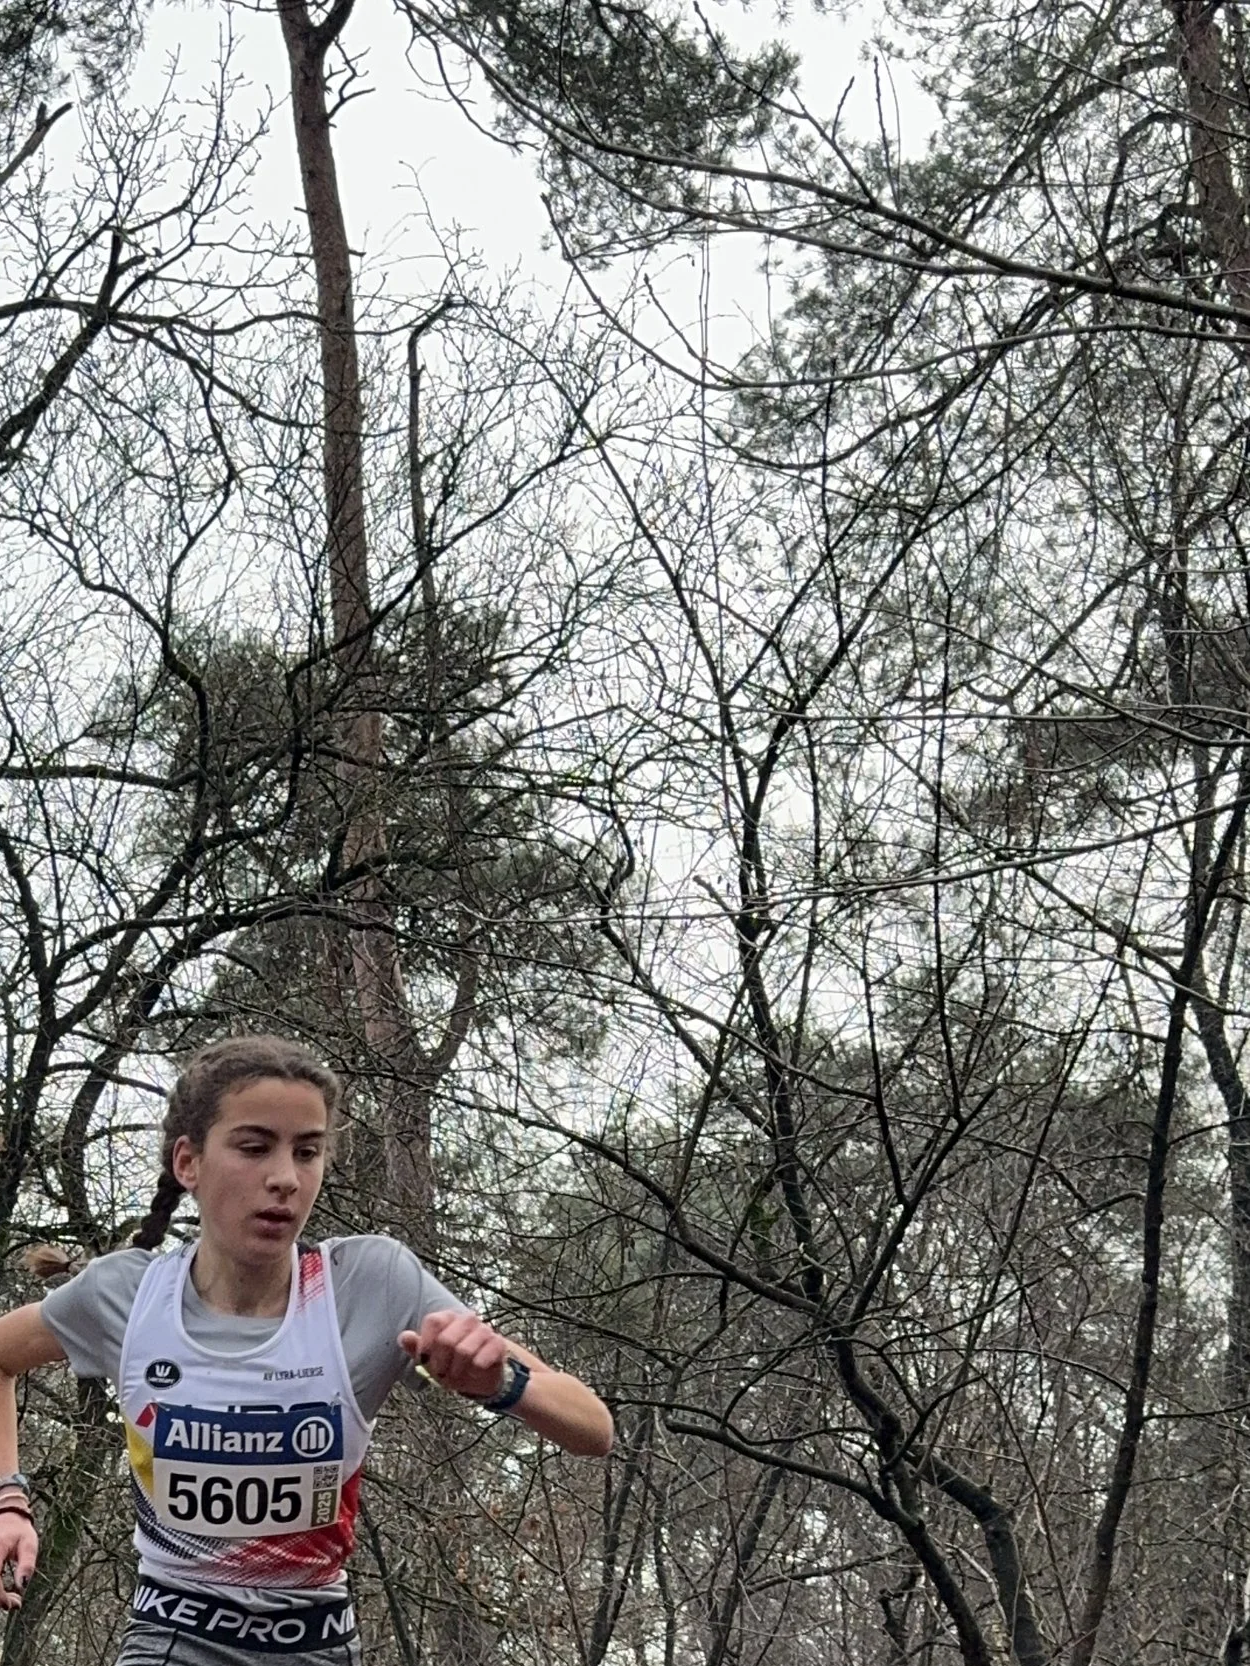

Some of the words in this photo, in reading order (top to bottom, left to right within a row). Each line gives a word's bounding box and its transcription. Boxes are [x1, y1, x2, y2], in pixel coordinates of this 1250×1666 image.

[164, 1418, 284, 1453] Allianz
[168, 1472, 302, 1525] 5605
[316, 1491, 332, 1524] 2025
[205, 1608, 306, 1644] PRO
